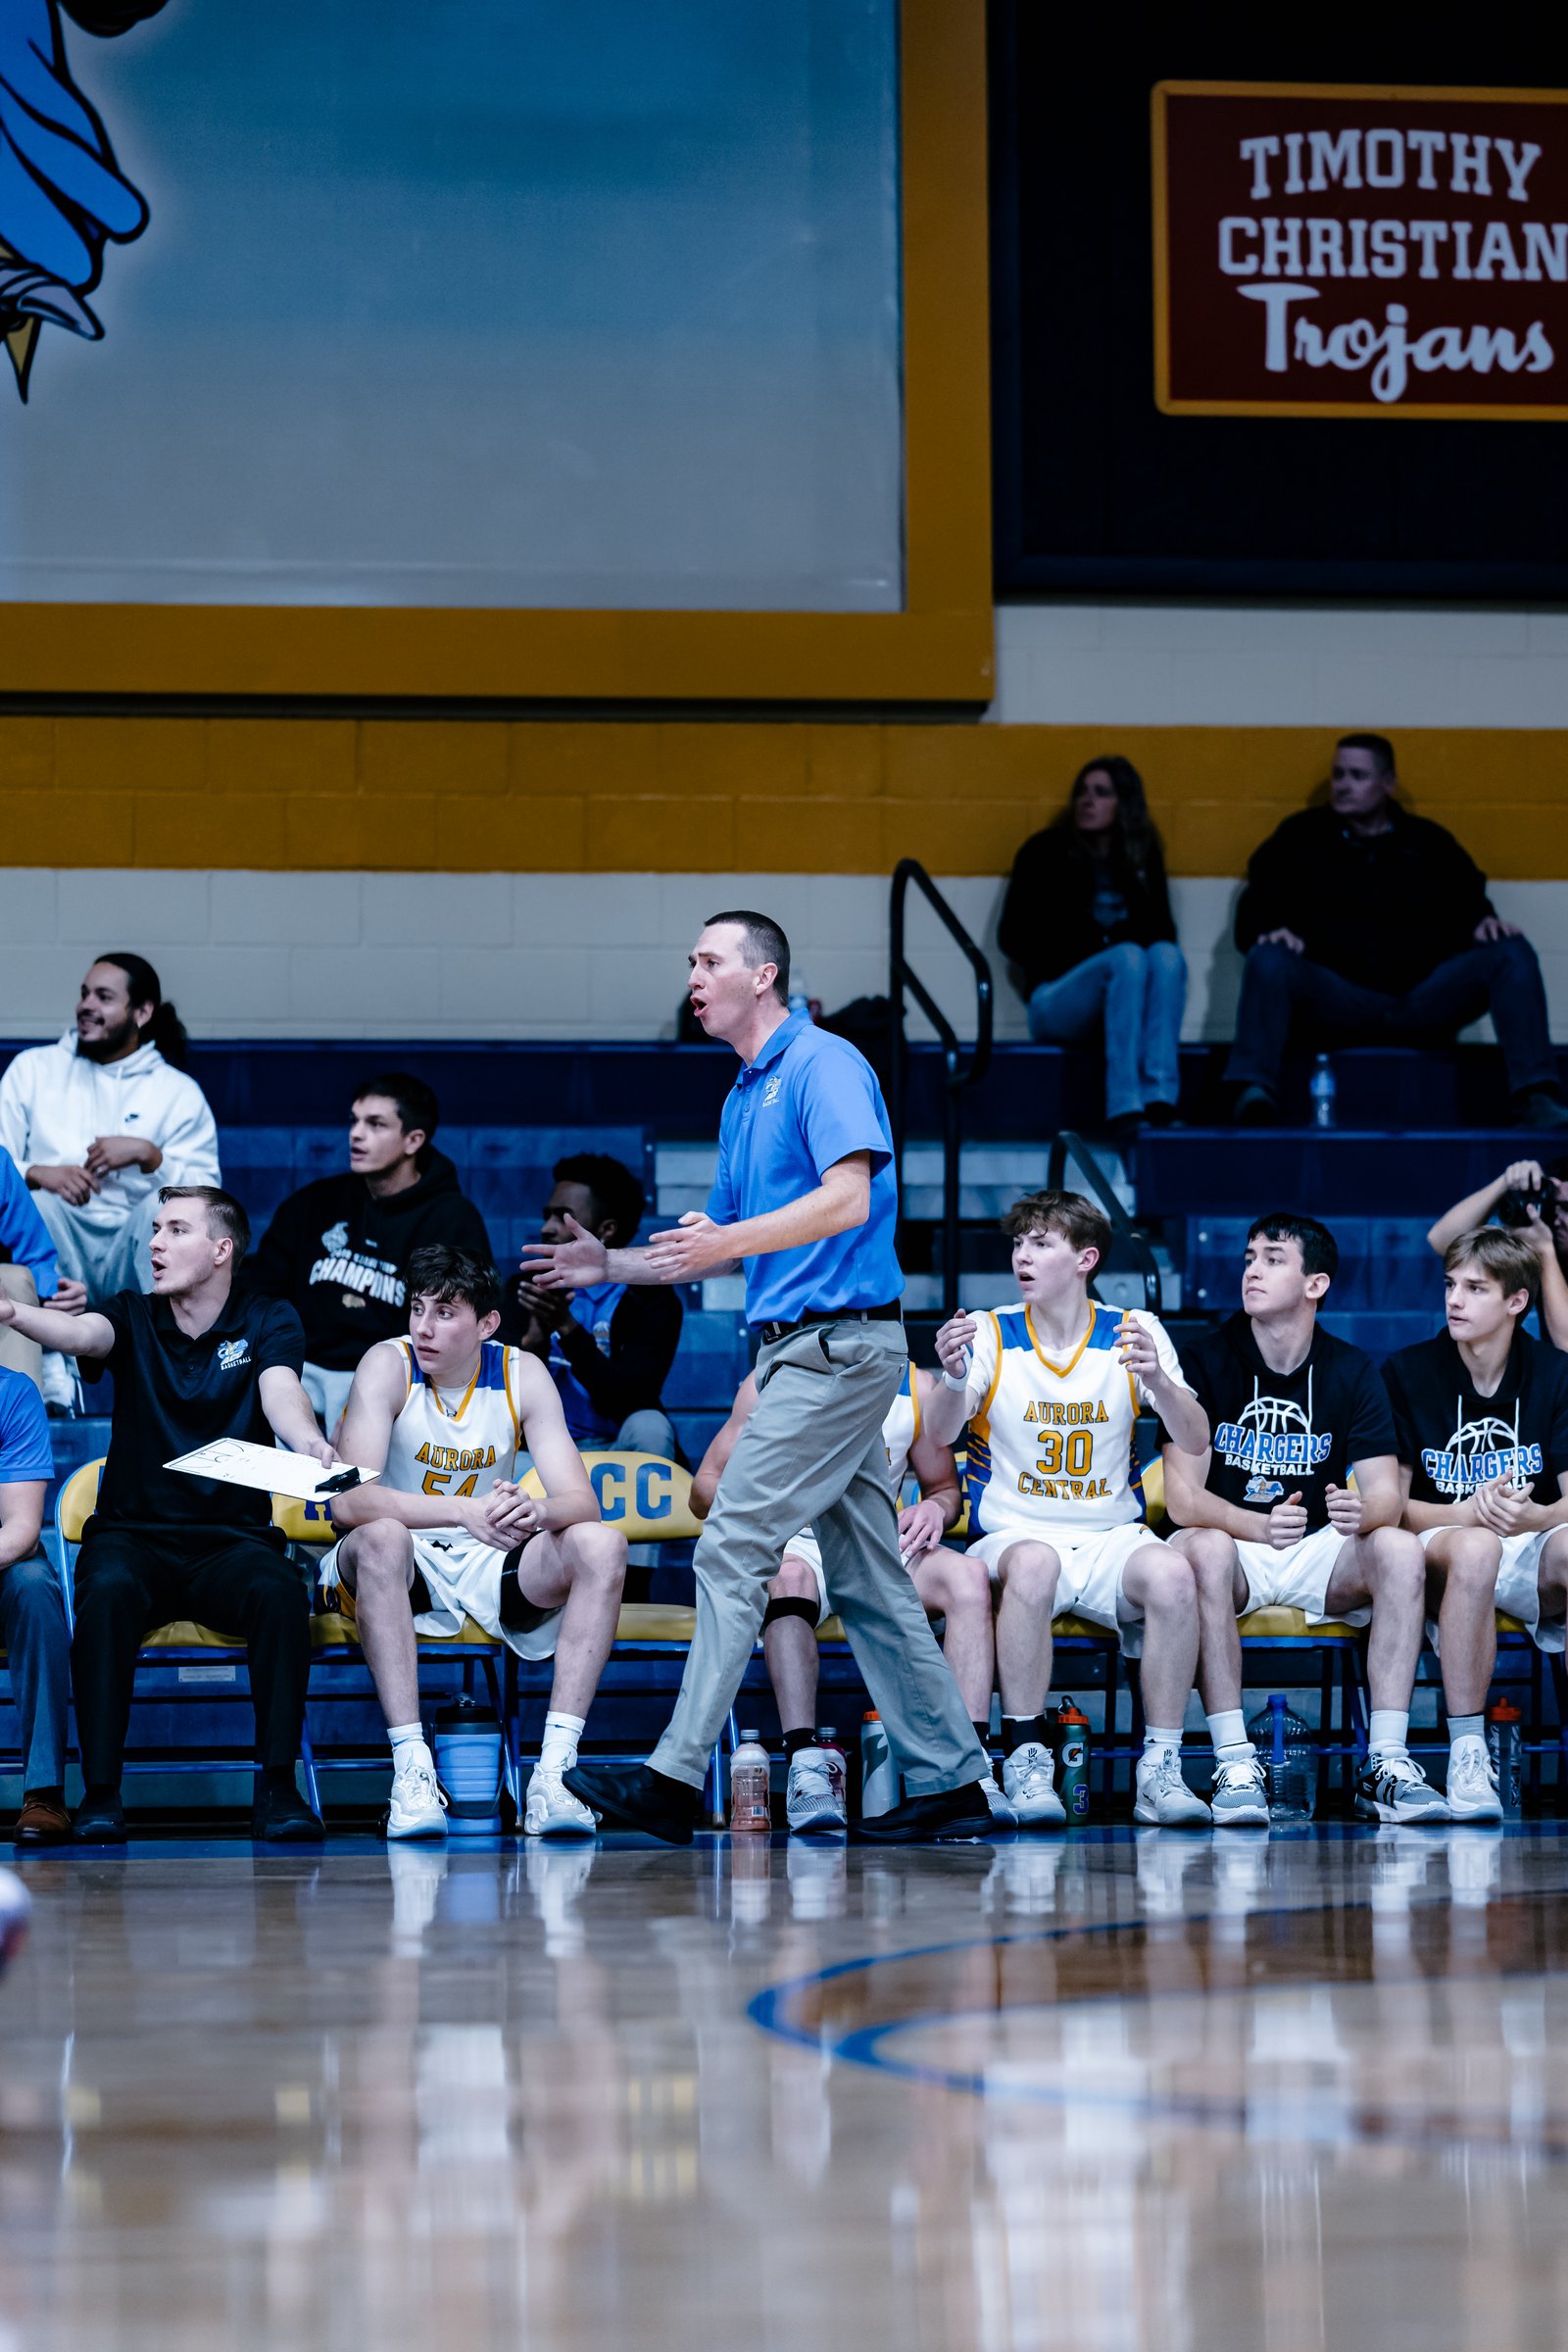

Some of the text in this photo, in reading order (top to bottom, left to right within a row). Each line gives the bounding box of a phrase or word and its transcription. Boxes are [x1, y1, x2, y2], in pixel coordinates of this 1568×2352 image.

[1240, 128, 1542, 202] TIMOTHY
[1218, 216, 1568, 281] CHRISTIAN
[1237, 282, 1554, 403] Trojans
[220, 1356, 252, 1371] BASKETBALL
[1023, 1399, 1108, 1425] AURORA
[415, 1442, 497, 1471] AURORA
[1036, 1430, 1093, 1477] 30
[1214, 1422, 1333, 1464] CHARGERS
[1225, 1454, 1314, 1476] BASKETBALL
[1421, 1443, 1544, 1484] CHARGERS
[590, 1462, 672, 1521] CC
[1018, 1471, 1112, 1500] CENTRAL
[1061, 1741, 1084, 1768] G
[1072, 1784, 1090, 1815] 3
